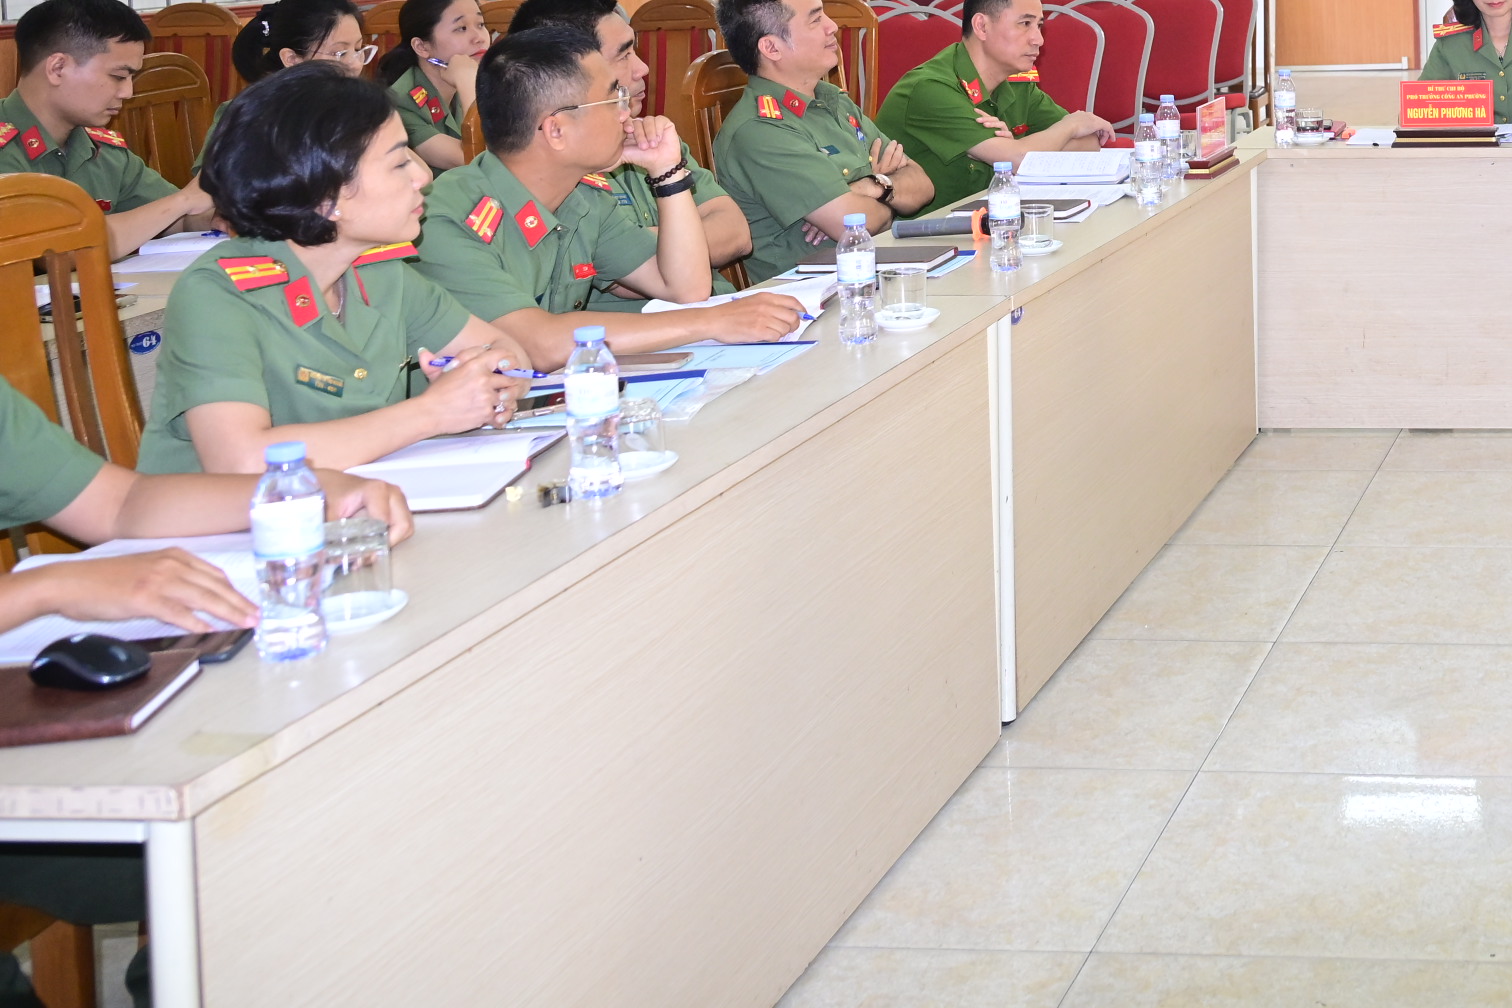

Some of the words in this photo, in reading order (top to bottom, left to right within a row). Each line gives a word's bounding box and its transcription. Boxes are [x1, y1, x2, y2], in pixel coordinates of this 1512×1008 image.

[1407, 104, 1439, 118] NGUYỄN
[1440, 106, 1473, 118] PHƯƠNG
[1475, 105, 1486, 118] HÀ
